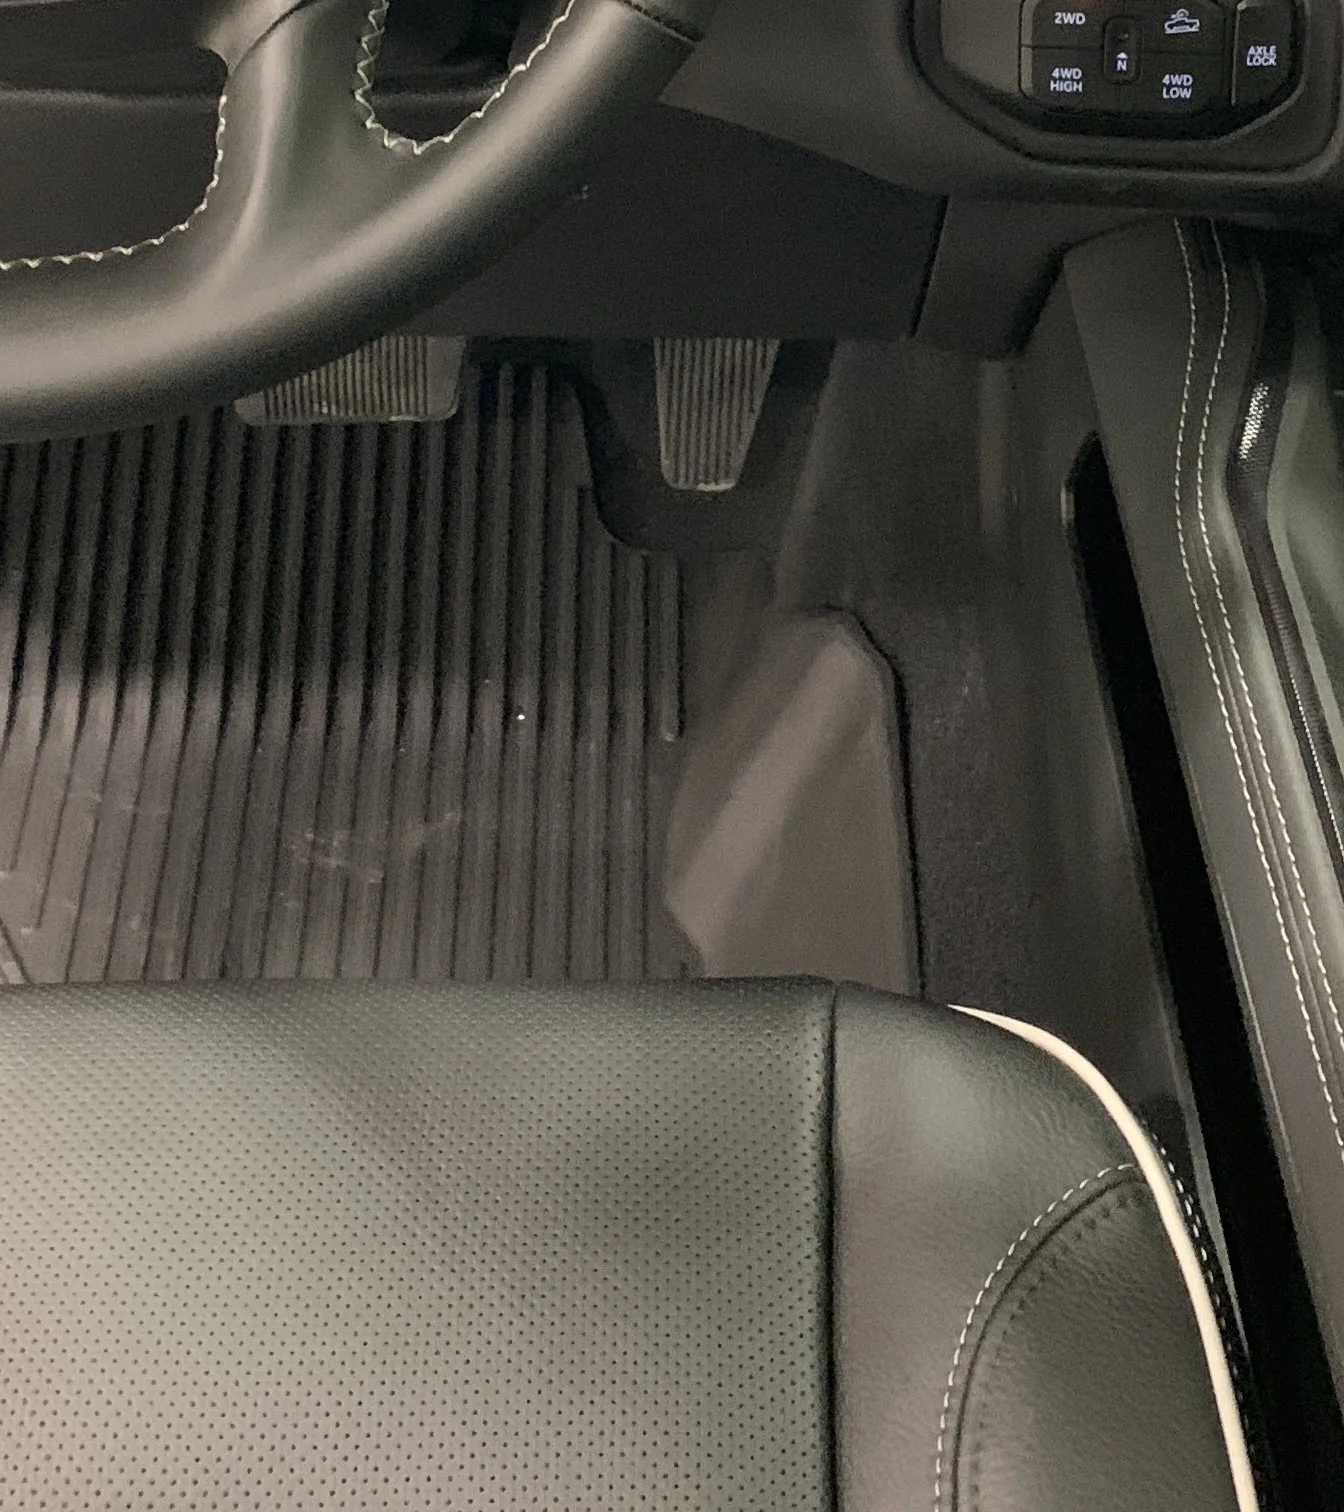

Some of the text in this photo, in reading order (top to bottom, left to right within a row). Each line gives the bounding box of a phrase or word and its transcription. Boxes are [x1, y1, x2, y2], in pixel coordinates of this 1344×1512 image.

[1054, 12, 1086, 25] 2WD
[1248, 45, 1277, 56] AXLE
[1116, 59, 1127, 71] N
[1246, 55, 1277, 66] LOCK
[1051, 68, 1082, 80] 4WD
[1162, 74, 1193, 86] 4WD
[1050, 81, 1083, 93] HIGH
[1162, 87, 1192, 99] LOW
